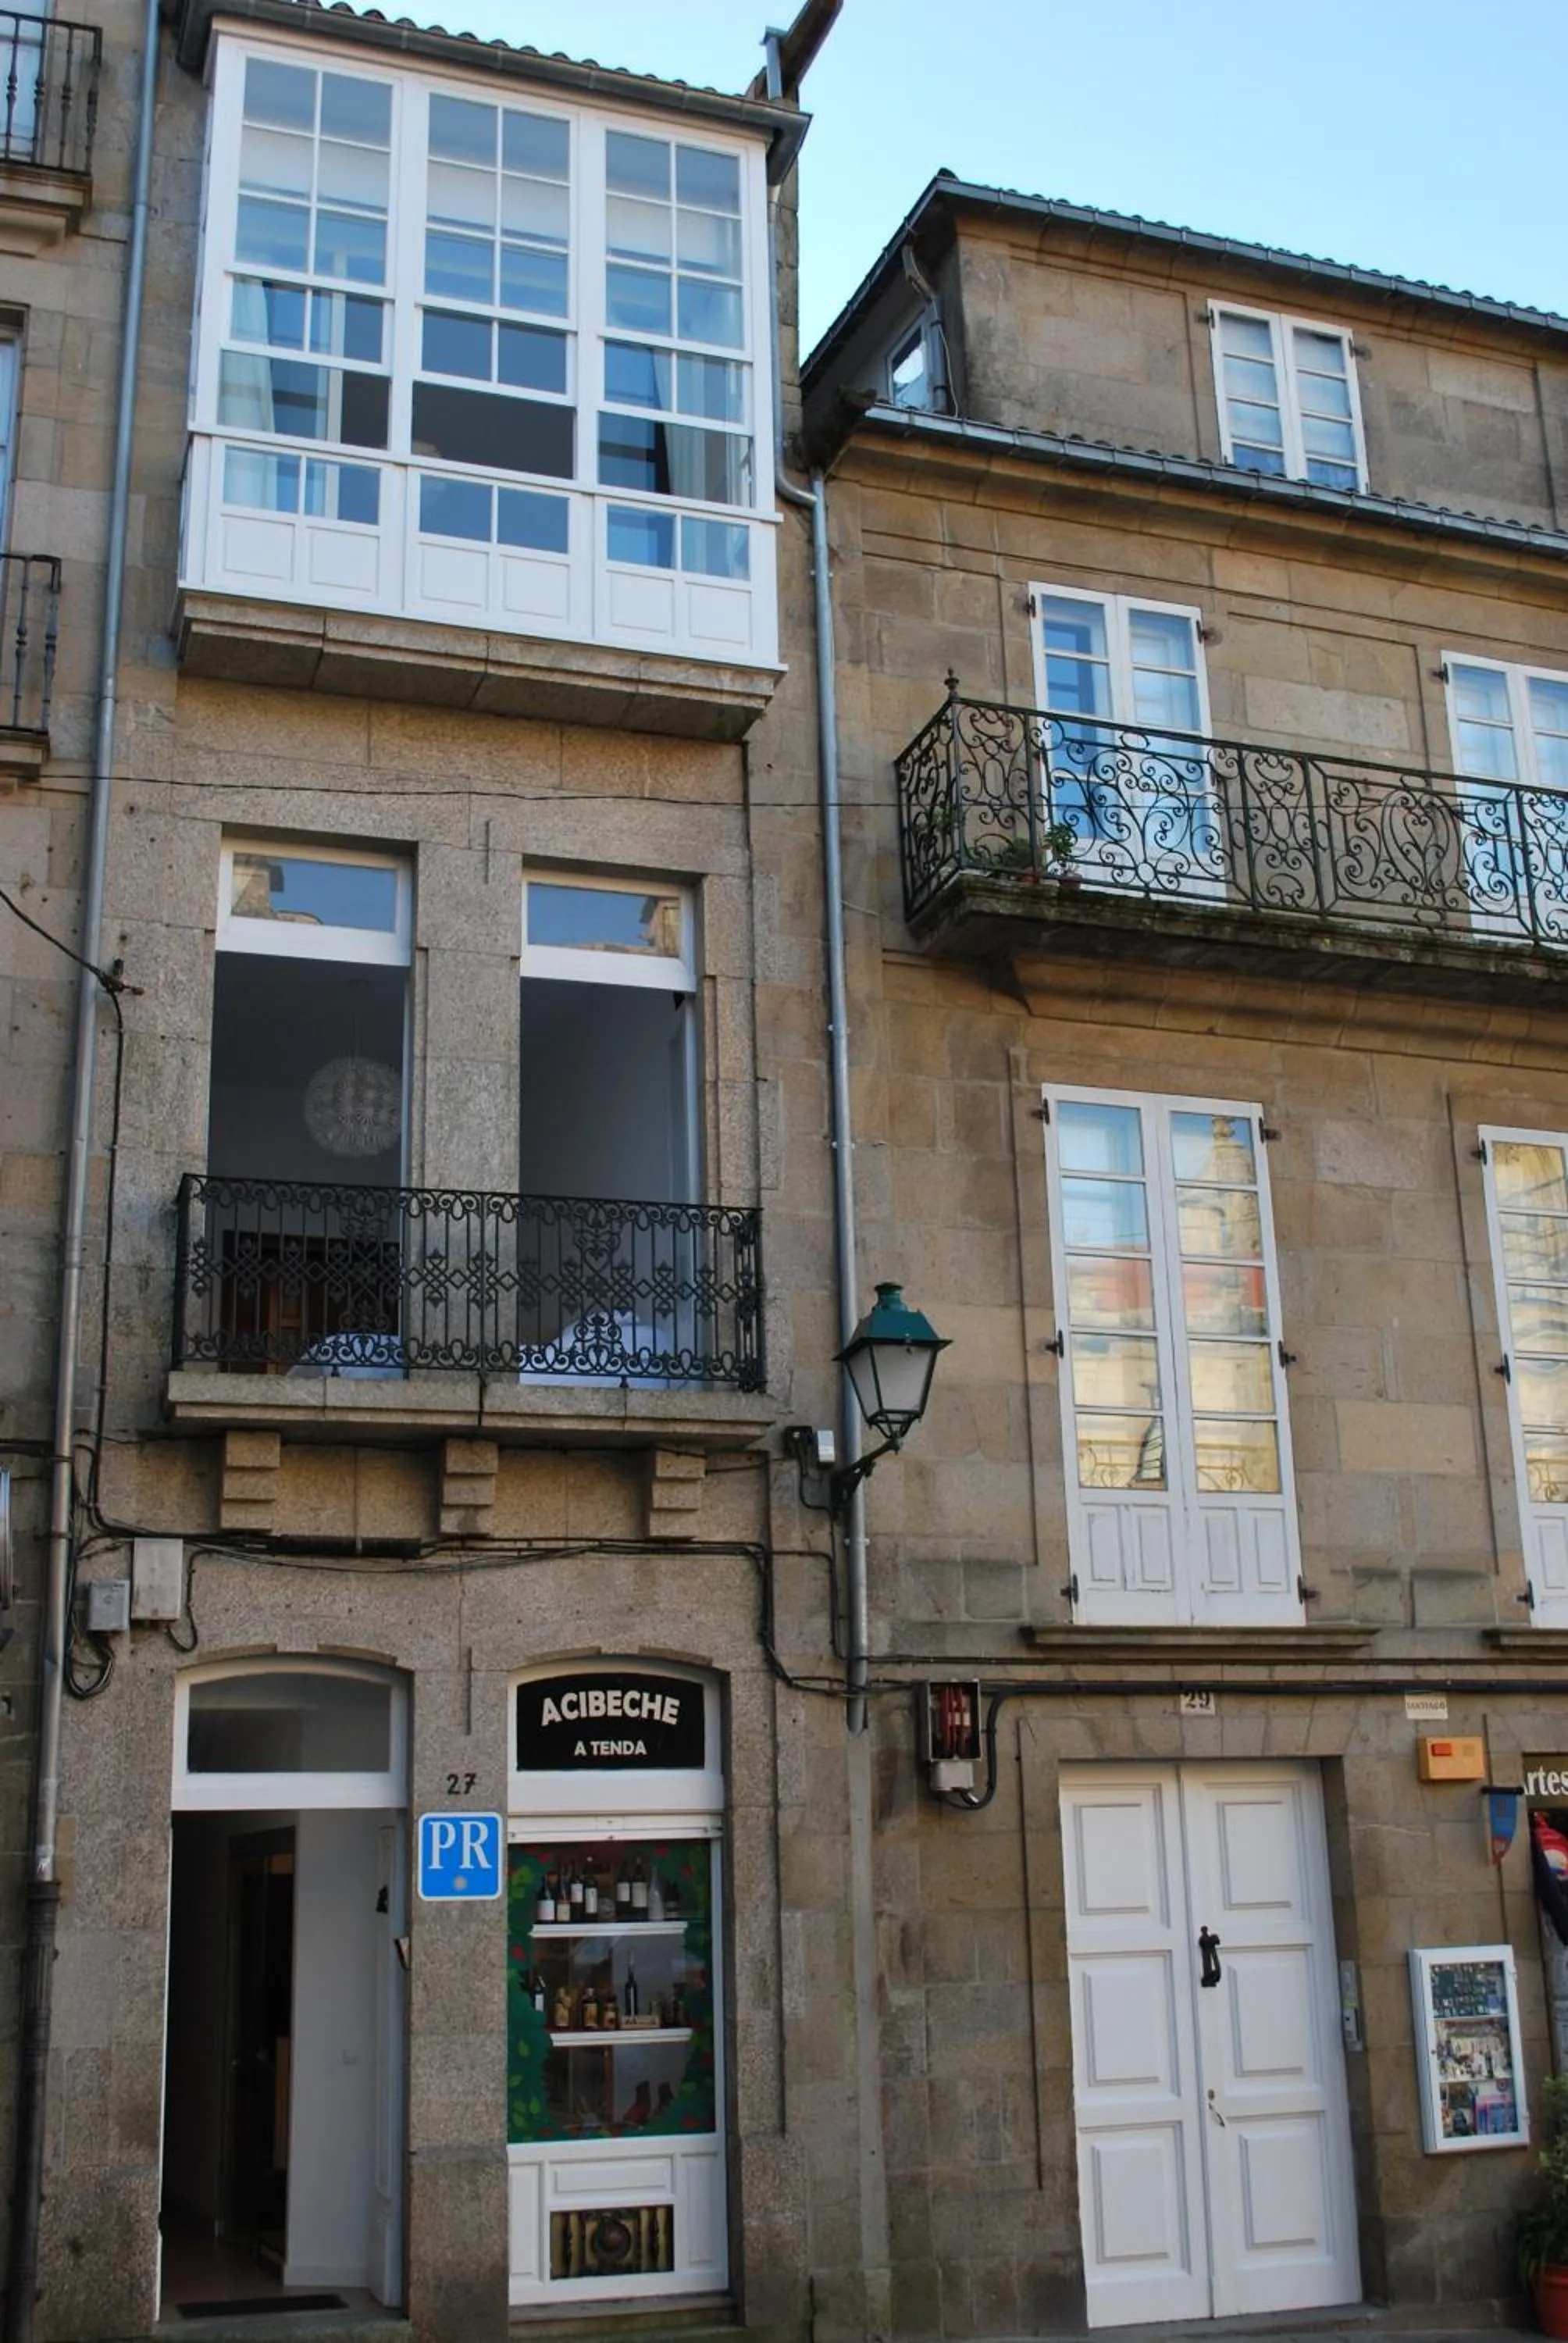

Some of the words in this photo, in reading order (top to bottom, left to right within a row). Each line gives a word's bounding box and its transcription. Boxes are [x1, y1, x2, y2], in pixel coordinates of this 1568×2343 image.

[541, 1690, 679, 1726] ACIBECHE
[574, 1741, 586, 1756] A
[590, 1740, 647, 1756] TENDA
[447, 1773, 477, 1795] 27
[1523, 1766, 1568, 1796] rtes
[428, 1821, 493, 1870] PR
